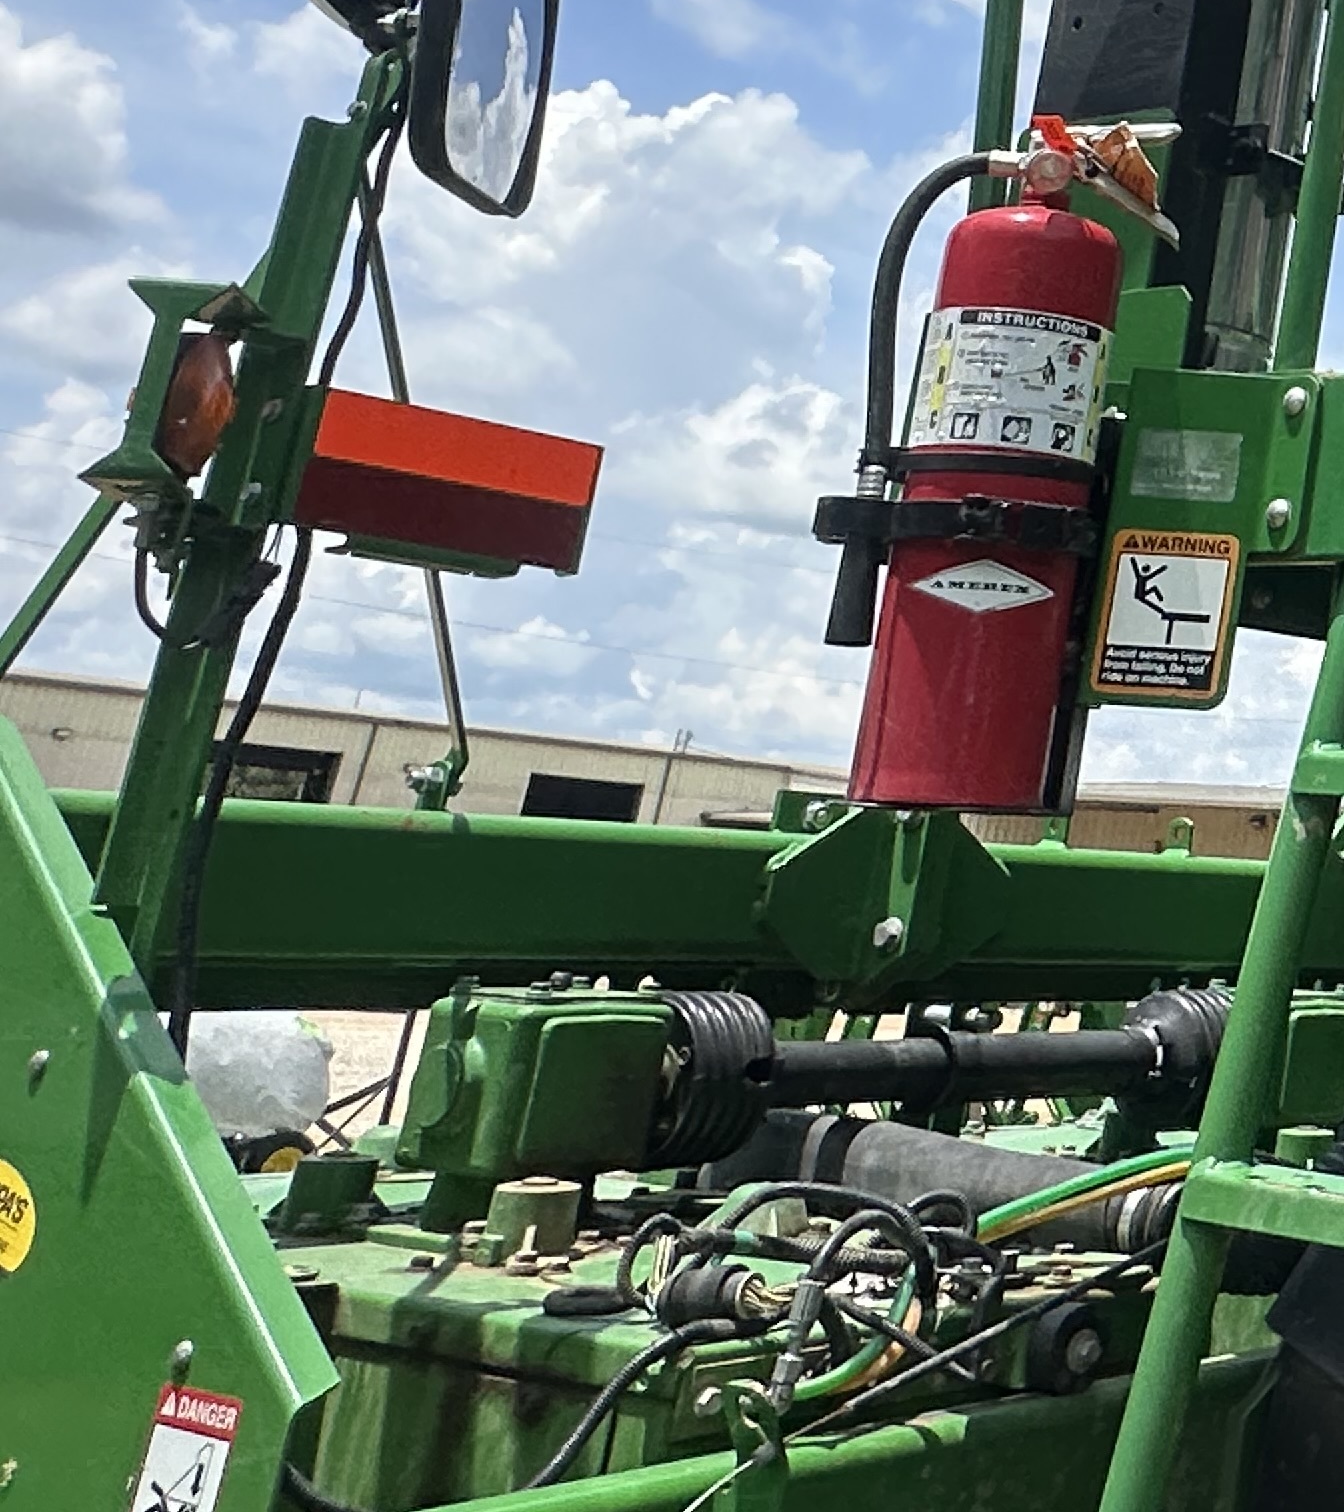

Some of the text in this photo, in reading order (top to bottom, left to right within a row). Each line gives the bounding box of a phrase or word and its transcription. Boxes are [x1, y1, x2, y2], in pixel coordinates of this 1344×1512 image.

[976, 310, 1089, 338] INSTRUCTIONS
[1141, 536, 1230, 555] WARNING
[177, 1394, 238, 1431] DANGER
